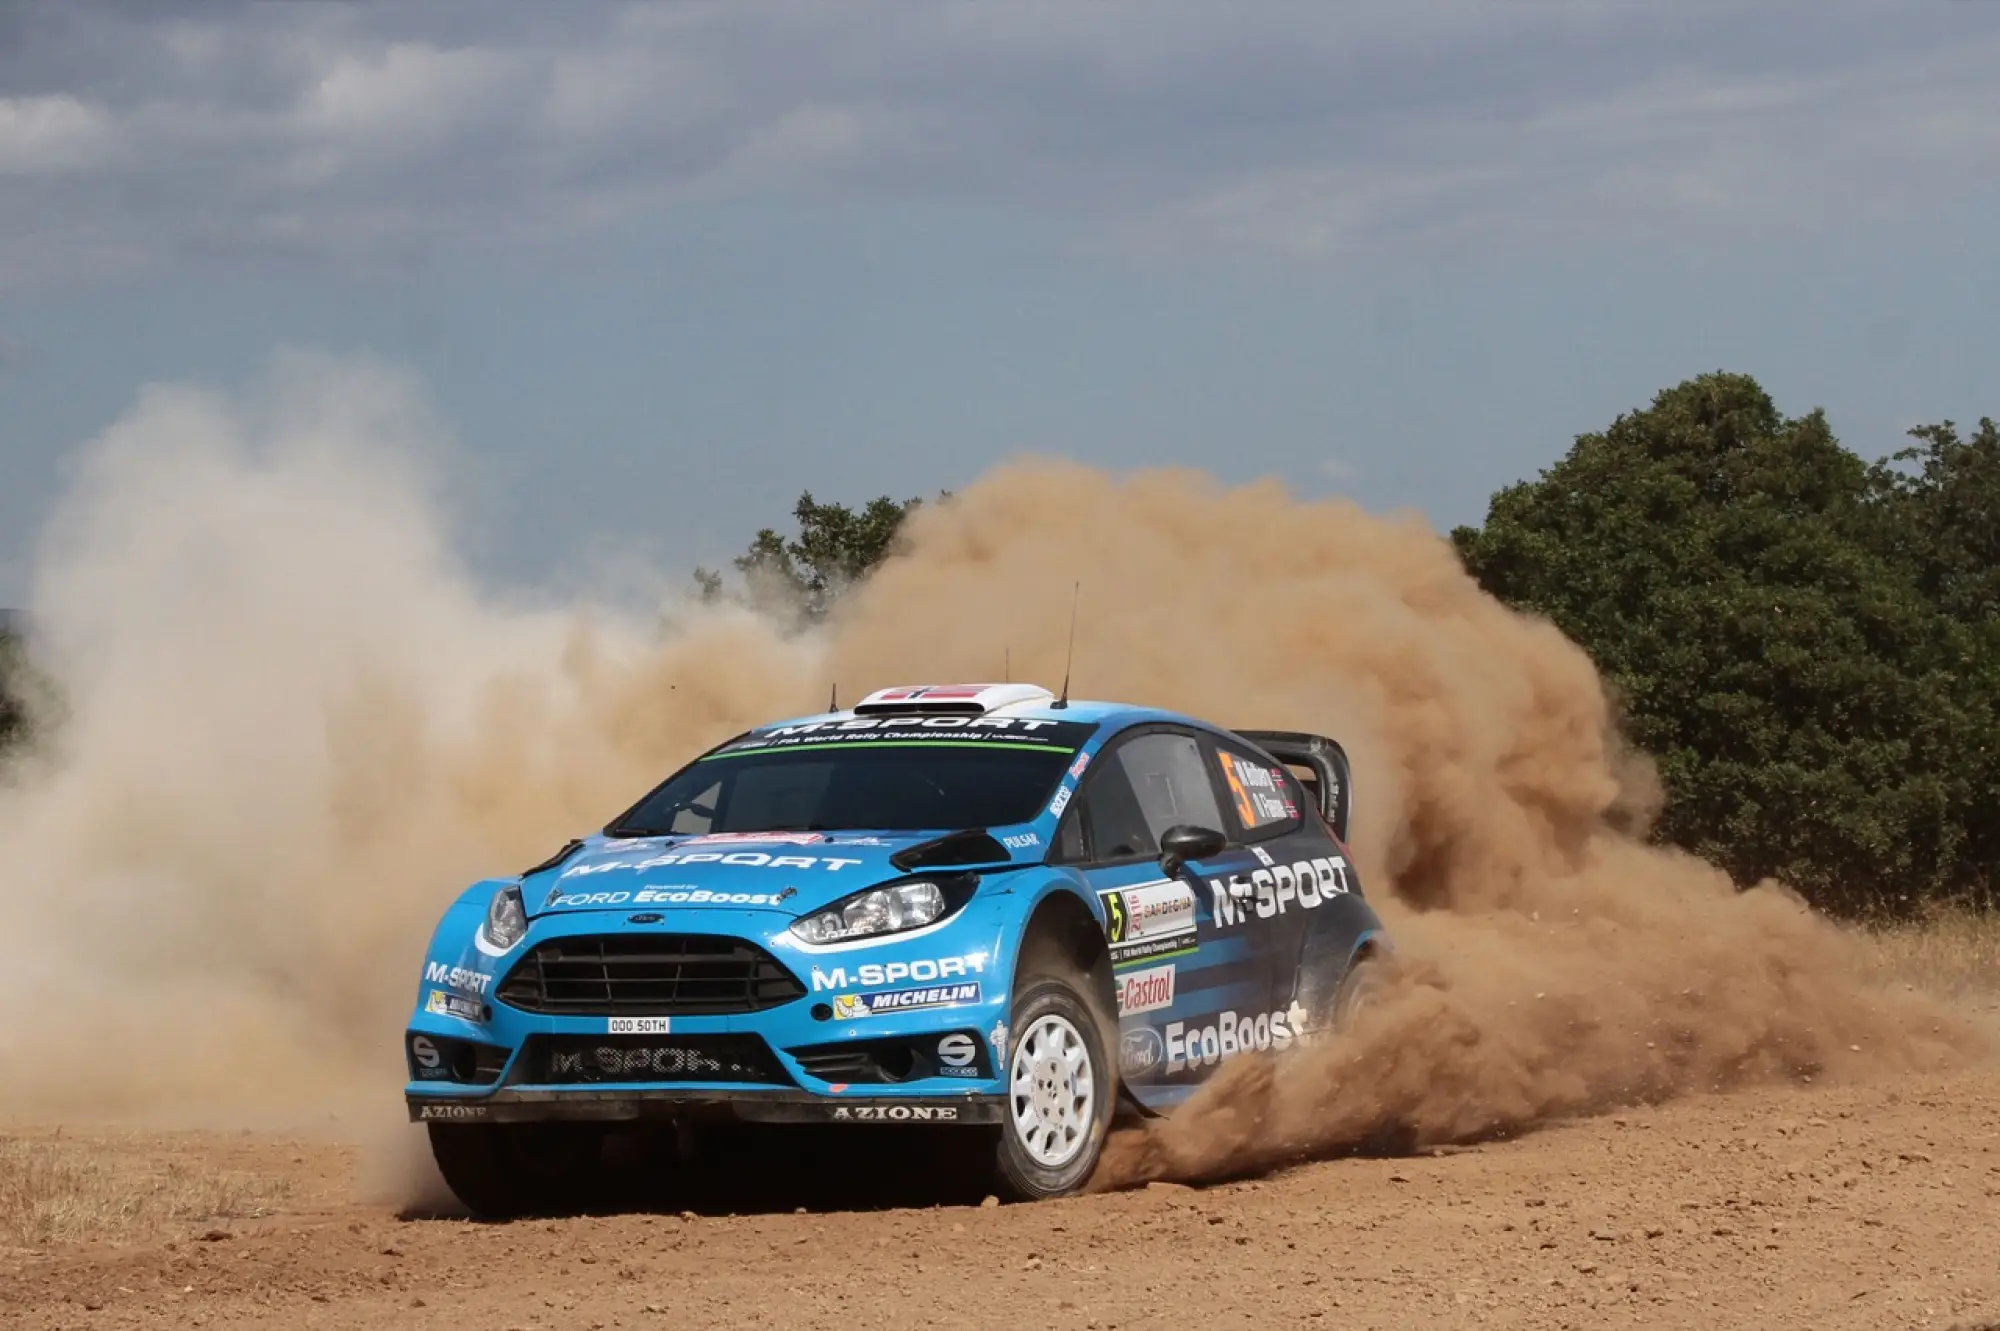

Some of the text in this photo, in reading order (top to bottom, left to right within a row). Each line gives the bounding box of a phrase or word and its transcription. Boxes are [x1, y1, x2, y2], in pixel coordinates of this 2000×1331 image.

[764, 717, 1058, 738] M-SPORT
[804, 734, 843, 743] World
[845, 732, 881, 741] Rally
[884, 731, 982, 740] Championship
[1217, 752, 1256, 828] 5
[561, 852, 862, 879] M-SPORT
[552, 890, 782, 908] FORD EcoBoost
[1108, 893, 1123, 943] 5
[426, 961, 491, 994] M-SPORT
[811, 951, 989, 992] M-SPORT
[872, 985, 976, 1009] MICHELIN
[1124, 971, 1170, 1010] Castrol
[1166, 1000, 1307, 1075] EcoBoost
[420, 1106, 487, 1118] AZIONE
[833, 1106, 957, 1121] AZIONE
